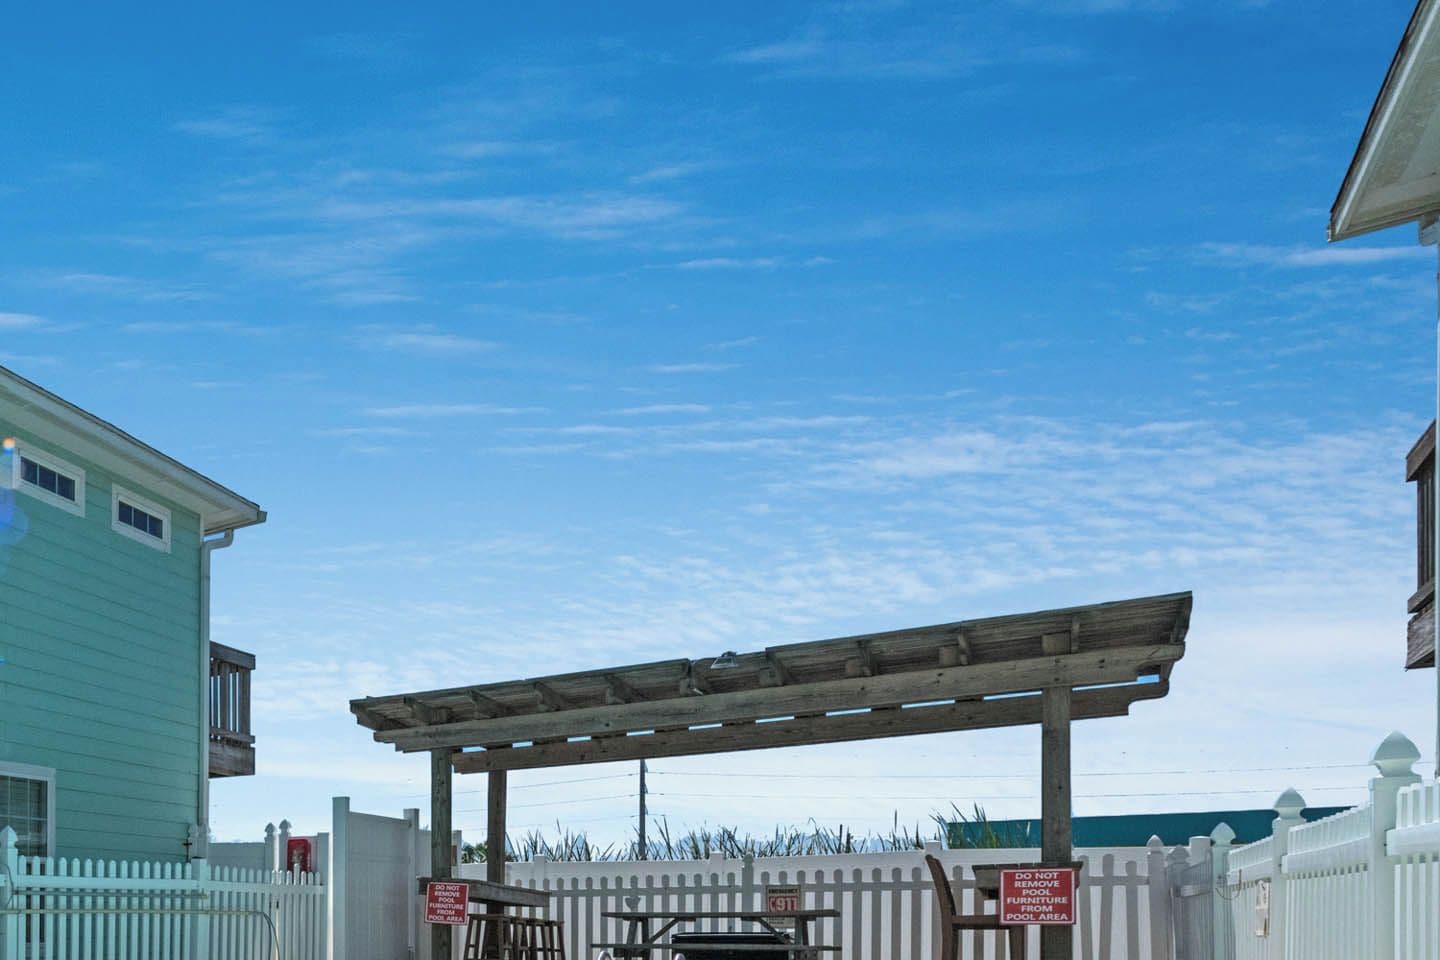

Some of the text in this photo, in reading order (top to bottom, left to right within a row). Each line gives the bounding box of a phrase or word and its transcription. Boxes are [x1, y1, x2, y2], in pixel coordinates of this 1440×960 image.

[1015, 872, 1032, 880] DO
[1014, 880, 1060, 888] REMOVE
[1022, 888, 1052, 896] POOL
[776, 896, 798, 911] 911
[1006, 896, 1069, 905] FURNITURE
[429, 902, 464, 910] FURNITURE
[1006, 913, 1069, 921] POOL AREA
